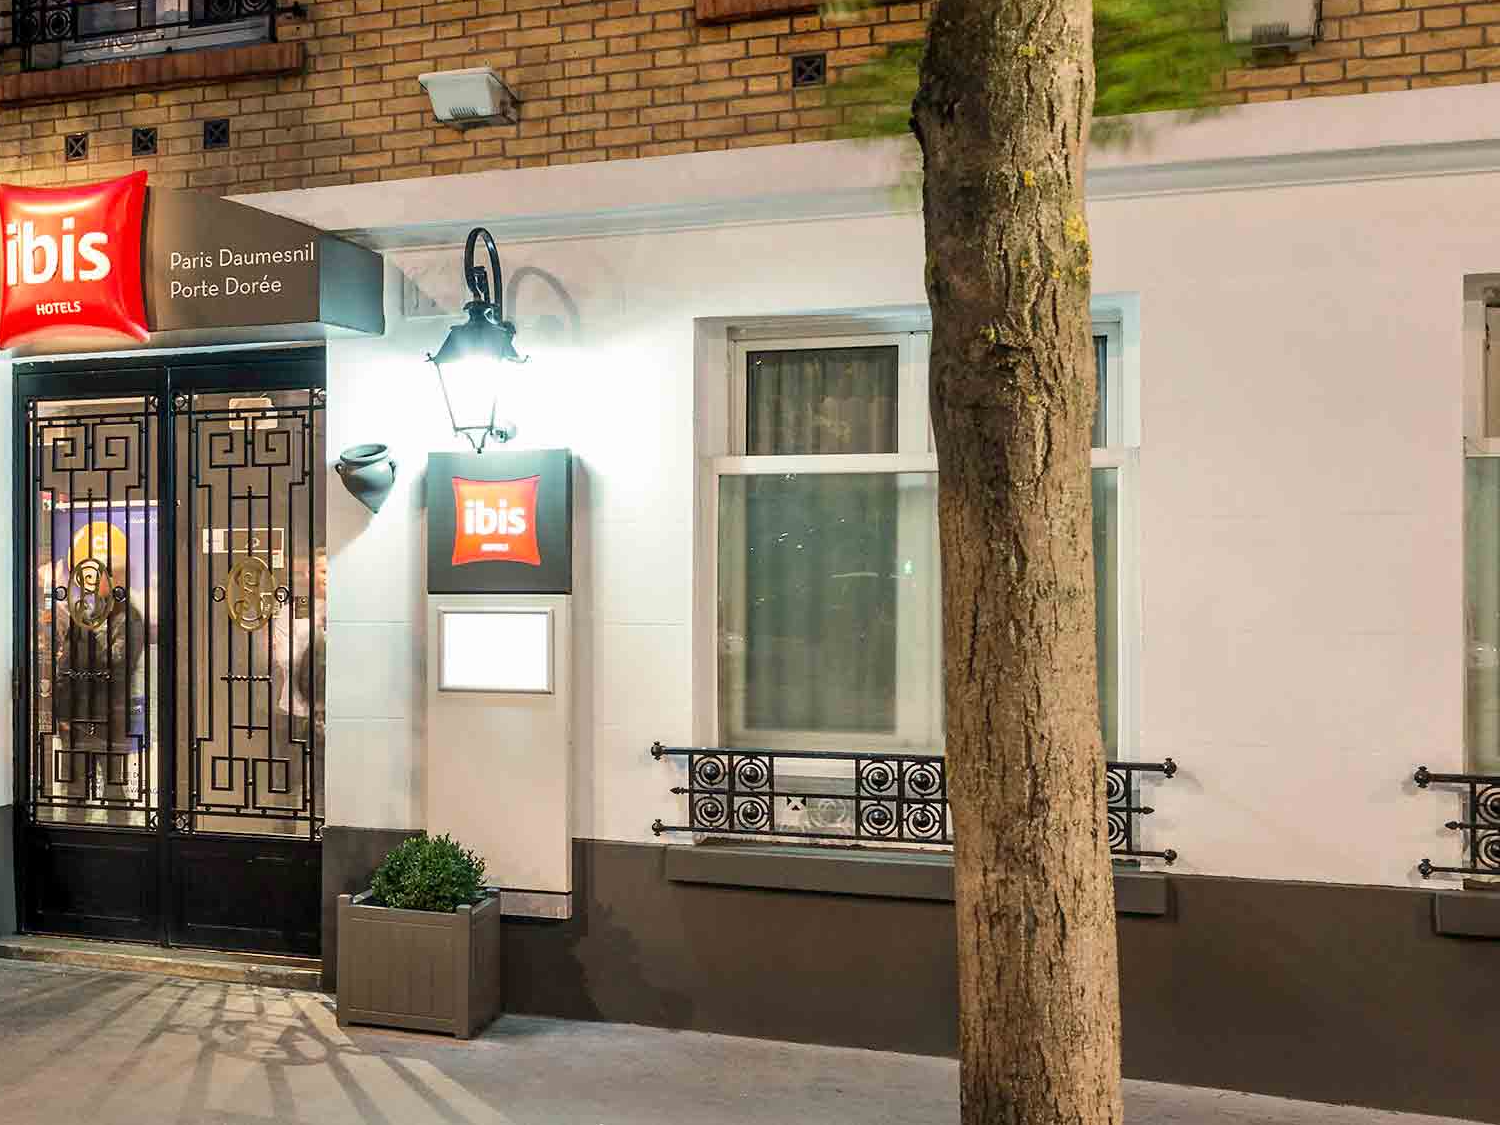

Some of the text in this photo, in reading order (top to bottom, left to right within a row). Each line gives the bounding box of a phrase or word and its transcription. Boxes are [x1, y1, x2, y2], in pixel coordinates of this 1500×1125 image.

[6, 216, 111, 287] ibis
[170, 242, 314, 270] Paris Daumesnil
[170, 275, 282, 299] Porte Dorée
[36, 301, 82, 316] HOTELS
[465, 499, 526, 535] ibis
